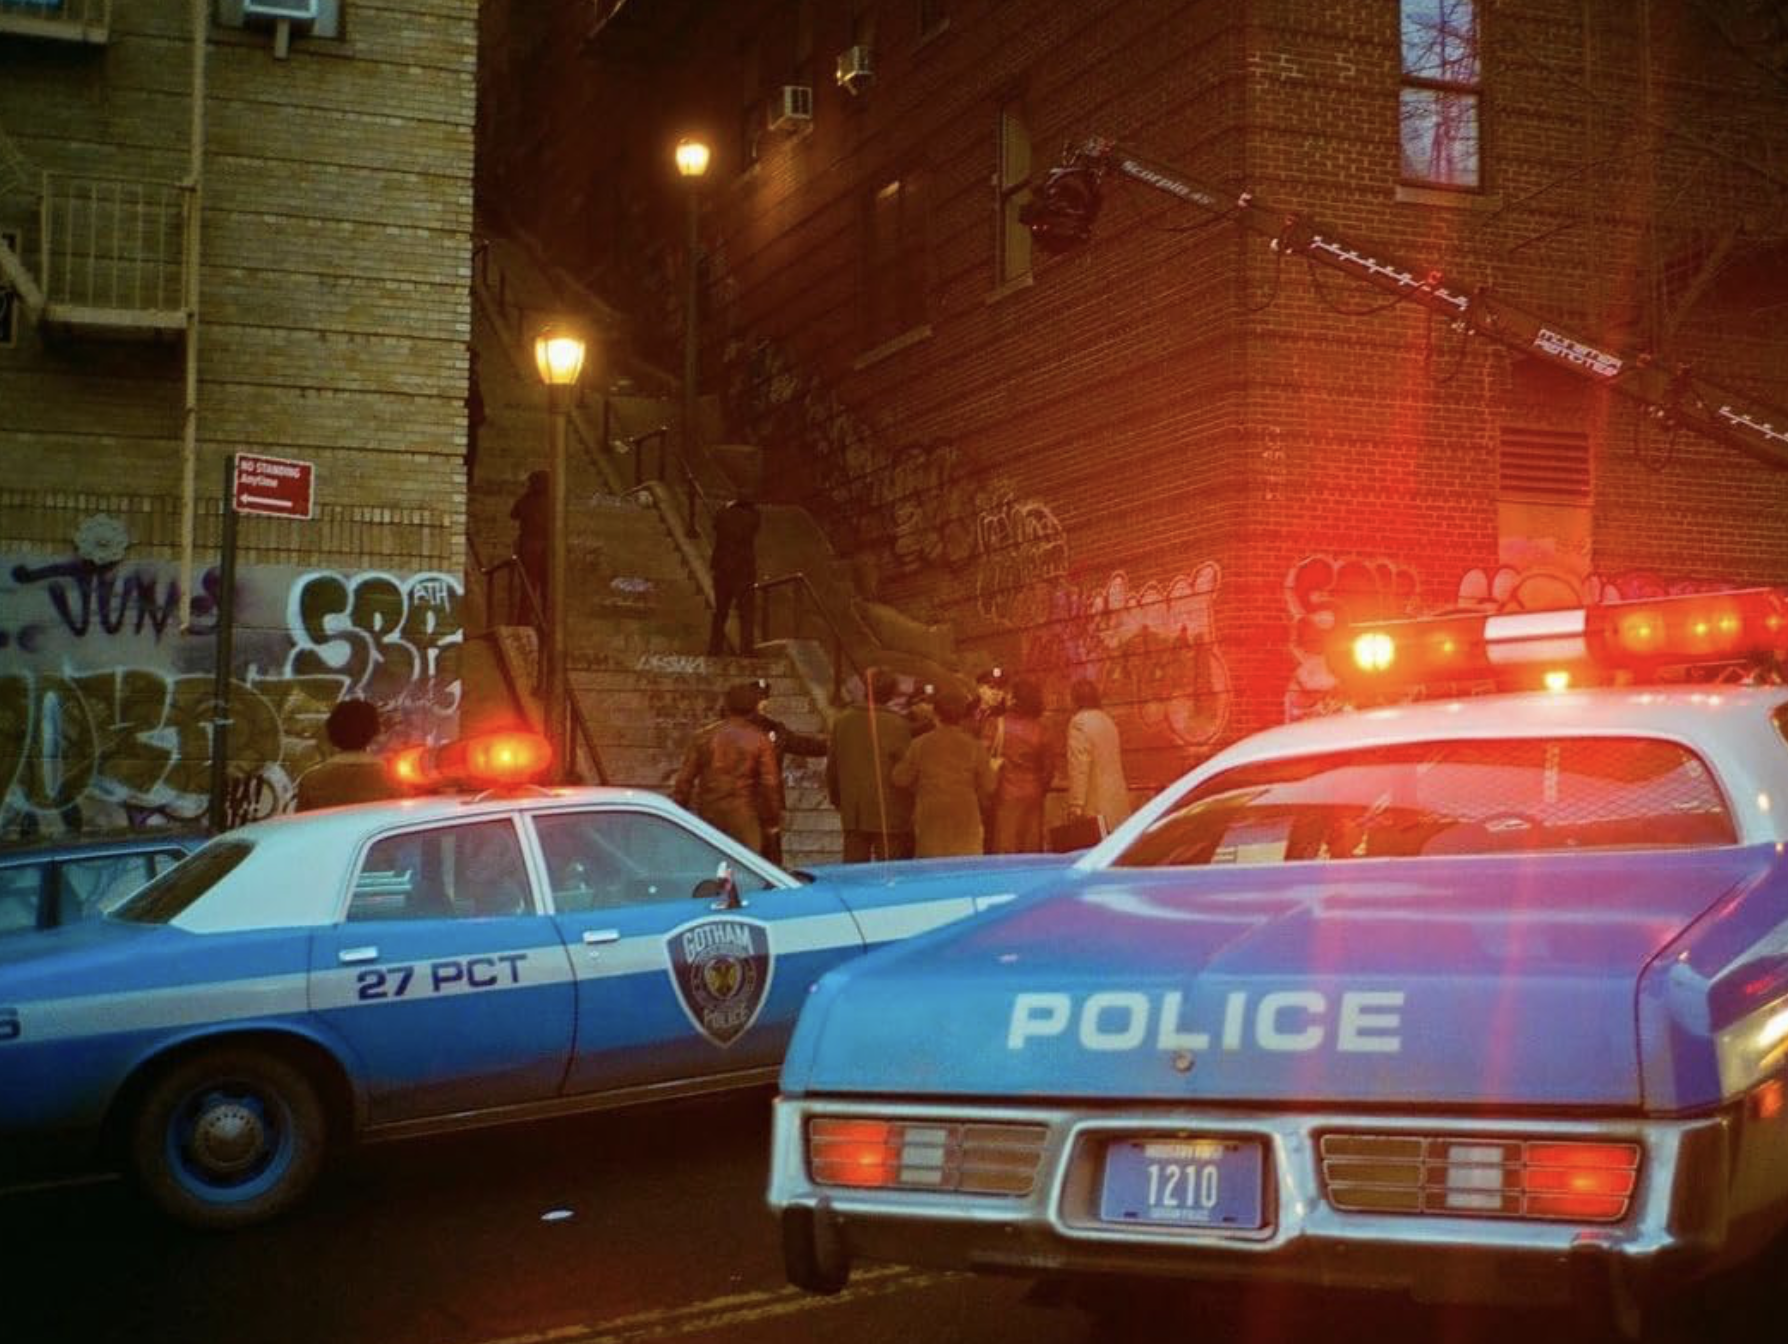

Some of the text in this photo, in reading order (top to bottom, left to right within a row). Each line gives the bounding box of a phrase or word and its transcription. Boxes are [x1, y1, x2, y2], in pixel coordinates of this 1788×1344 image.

[240, 473, 279, 487] Anytime
[256, 462, 301, 478] STANDING
[682, 923, 754, 964] GOTHAM
[356, 953, 528, 1000] 27 PCT
[703, 1000, 751, 1028] POLICE
[1007, 991, 1405, 1052] POLICE
[1148, 1164, 1218, 1207] 1210
